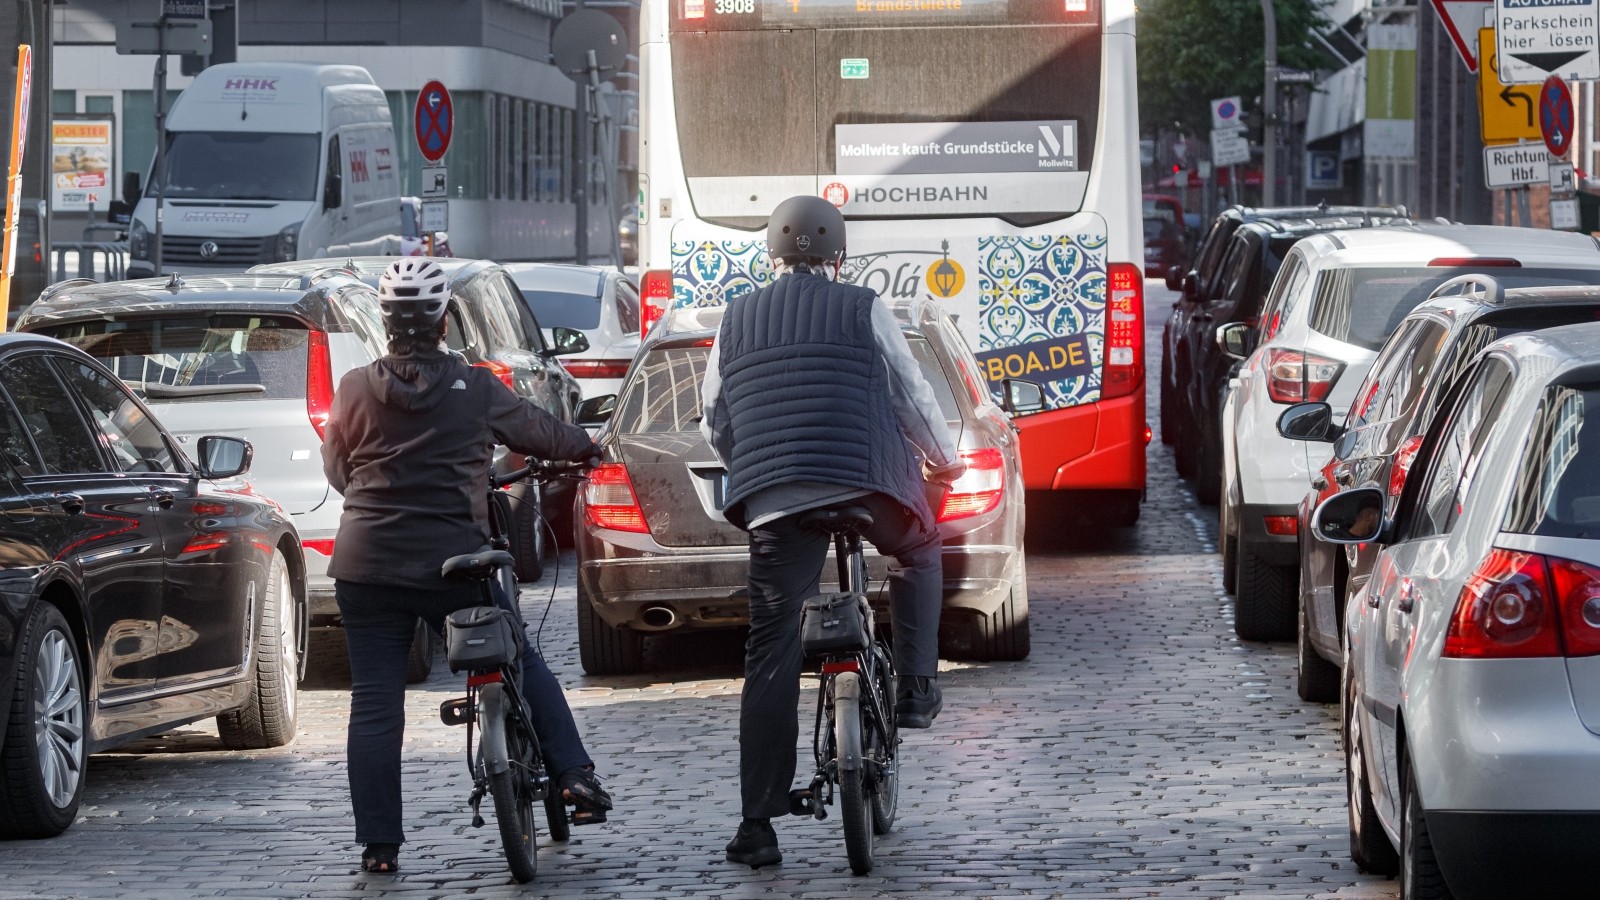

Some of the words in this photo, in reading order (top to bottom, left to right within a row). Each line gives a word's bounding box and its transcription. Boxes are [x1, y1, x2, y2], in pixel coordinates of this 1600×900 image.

[714, 0, 755, 14] 3908
[1503, 13, 1593, 30] Parkschein
[1503, 35, 1535, 48] hier
[1549, 33, 1594, 47] lösen
[225, 79, 277, 89] HHK
[55, 127, 106, 136] POLSTER
[840, 143, 899, 157] Mollwitz
[902, 141, 940, 156] kauft
[944, 141, 1035, 155] Grundstücke
[349, 149, 369, 184] HHK
[1038, 159, 1073, 167] Mollwitz
[1511, 166, 1539, 181] Hbf.
[854, 186, 988, 203] HOCHBAHN
[863, 263, 921, 298] Olá
